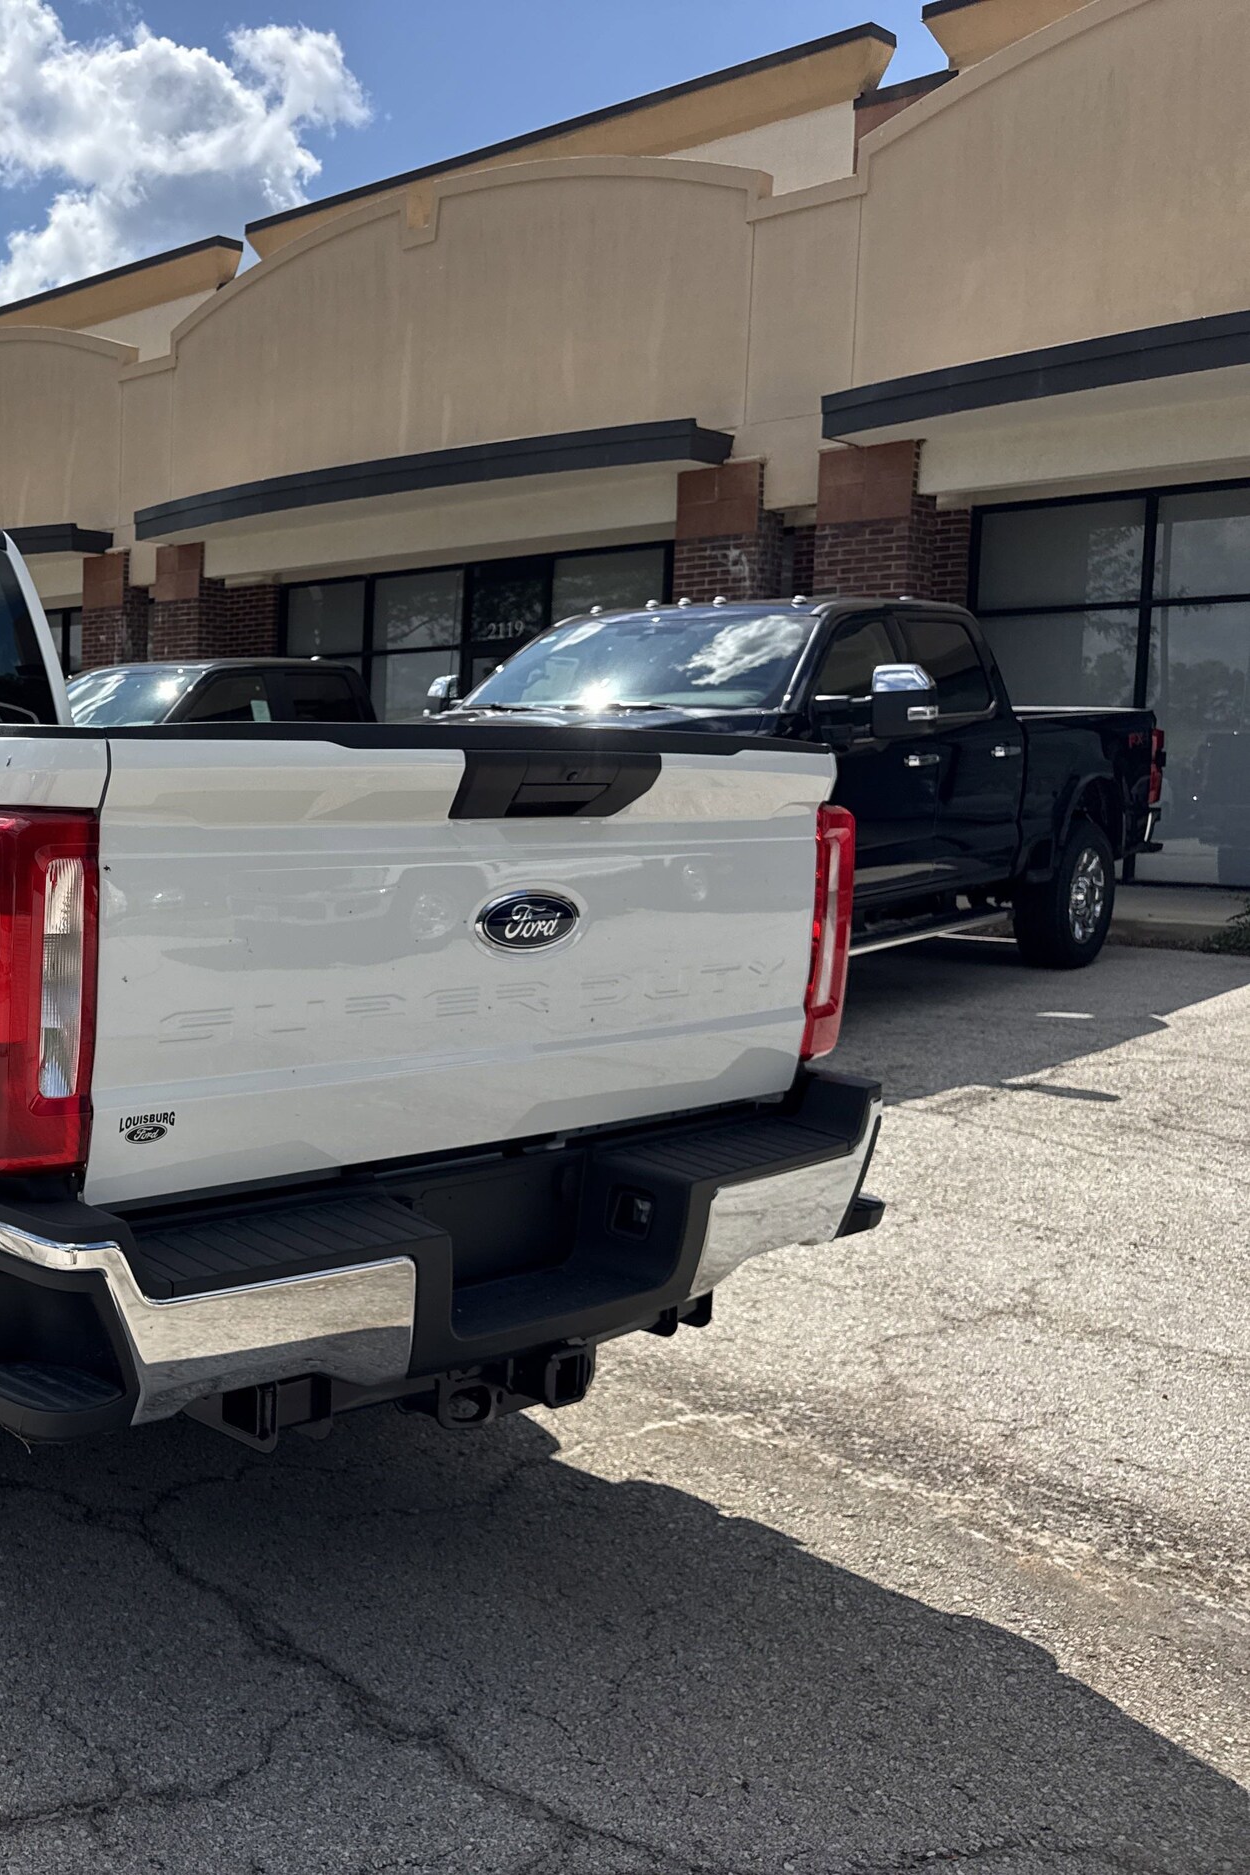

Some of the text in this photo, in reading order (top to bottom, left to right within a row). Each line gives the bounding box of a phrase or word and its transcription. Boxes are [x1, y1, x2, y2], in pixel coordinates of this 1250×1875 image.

[487, 620, 525, 640] 2119
[504, 903, 562, 939] Ford
[157, 958, 786, 1043] SUPER DUTY
[119, 1111, 175, 1133] LOUISBURG
